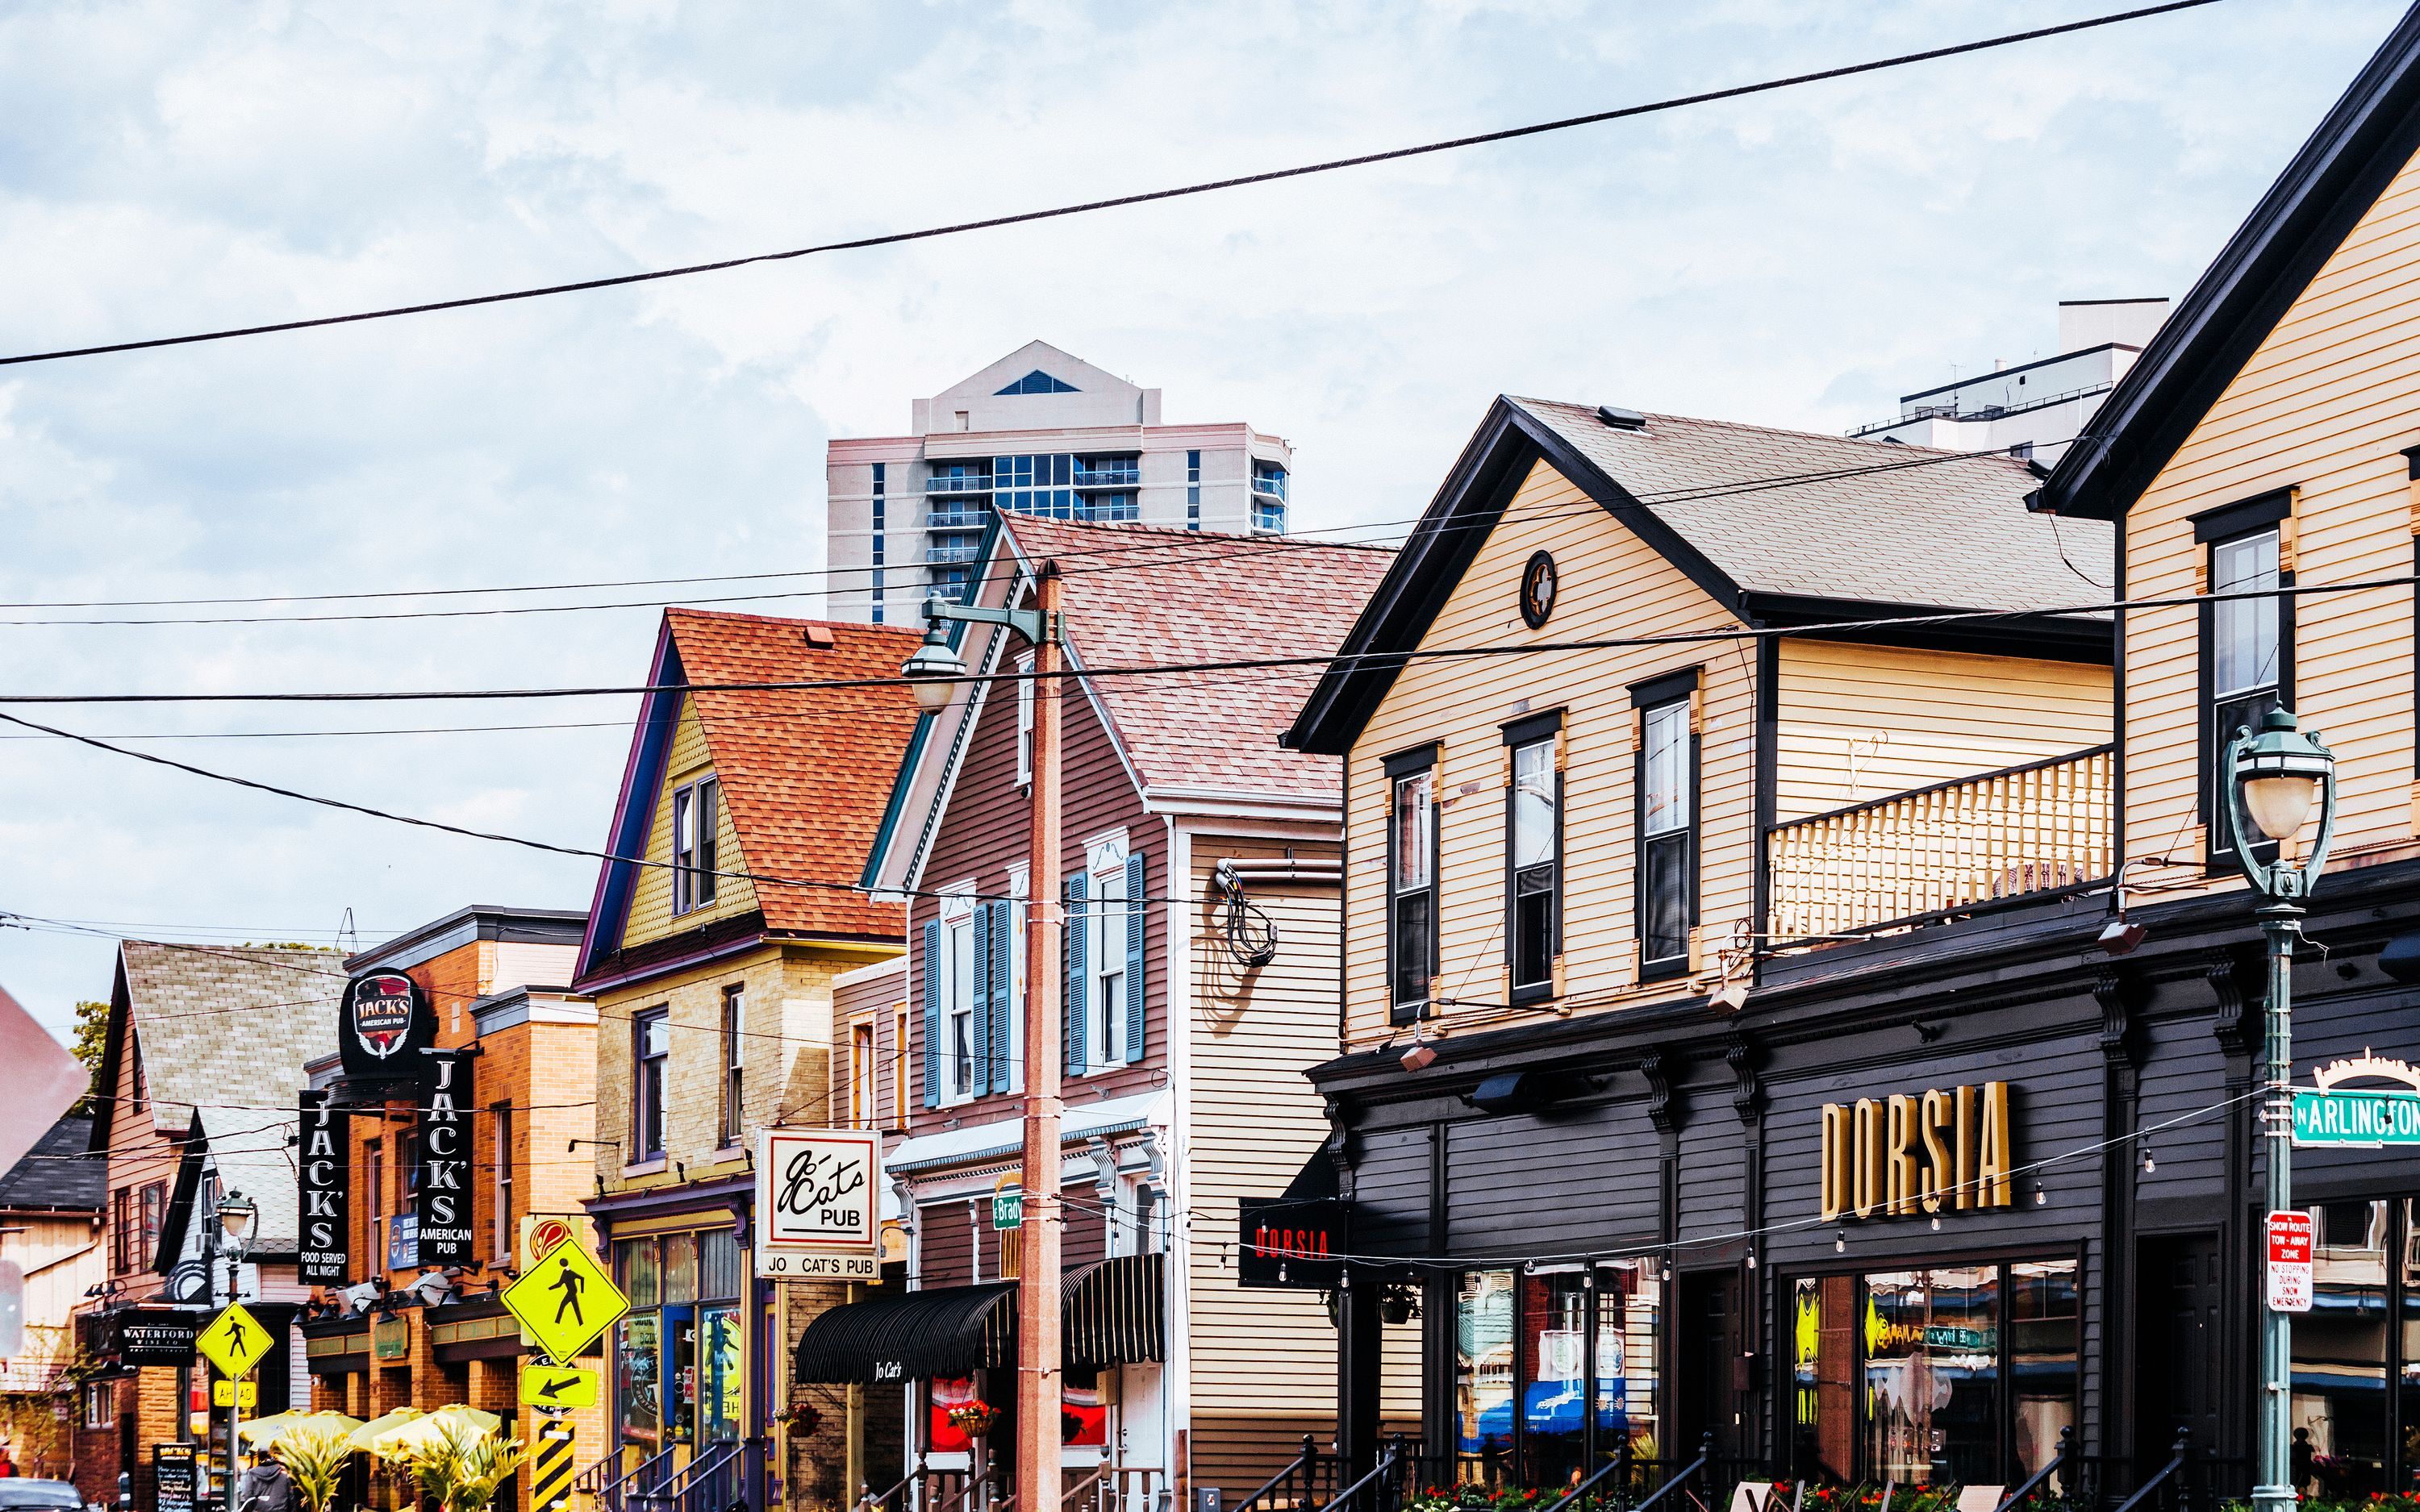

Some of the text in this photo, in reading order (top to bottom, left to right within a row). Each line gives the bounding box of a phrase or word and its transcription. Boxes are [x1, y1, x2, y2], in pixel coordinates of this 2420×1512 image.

[357, 998, 409, 1019] JACK'S
[2297, 1107, 2306, 1126] N
[426, 1060, 467, 1224] JACK'S
[1821, 1081, 2011, 1223] DORSIA
[306, 1101, 344, 1248] JACK'S
[821, 1209, 861, 1227] PUB
[2269, 1222, 2310, 1233] SNOW ROUTE
[420, 1228, 472, 1242] AMERICAN
[436, 1242, 457, 1254] PUB
[1256, 1228, 1328, 1260] DORSIA
[301, 1252, 345, 1264] FOOD SERVED
[2281, 1248, 2300, 1260] ZONE
[306, 1265, 339, 1277] ALL NIGHT
[769, 1257, 874, 1274] JO CAT'S PUB
[2271, 1264, 2309, 1274] NO STOPPING
[2279, 1275, 2301, 1285] DURING
[2282, 1286, 2298, 1295] SNOW
[123, 1329, 194, 1339] WATERFORD
[875, 1360, 902, 1382] Jo Cat's
[219, 1388, 252, 1401] AHAD
